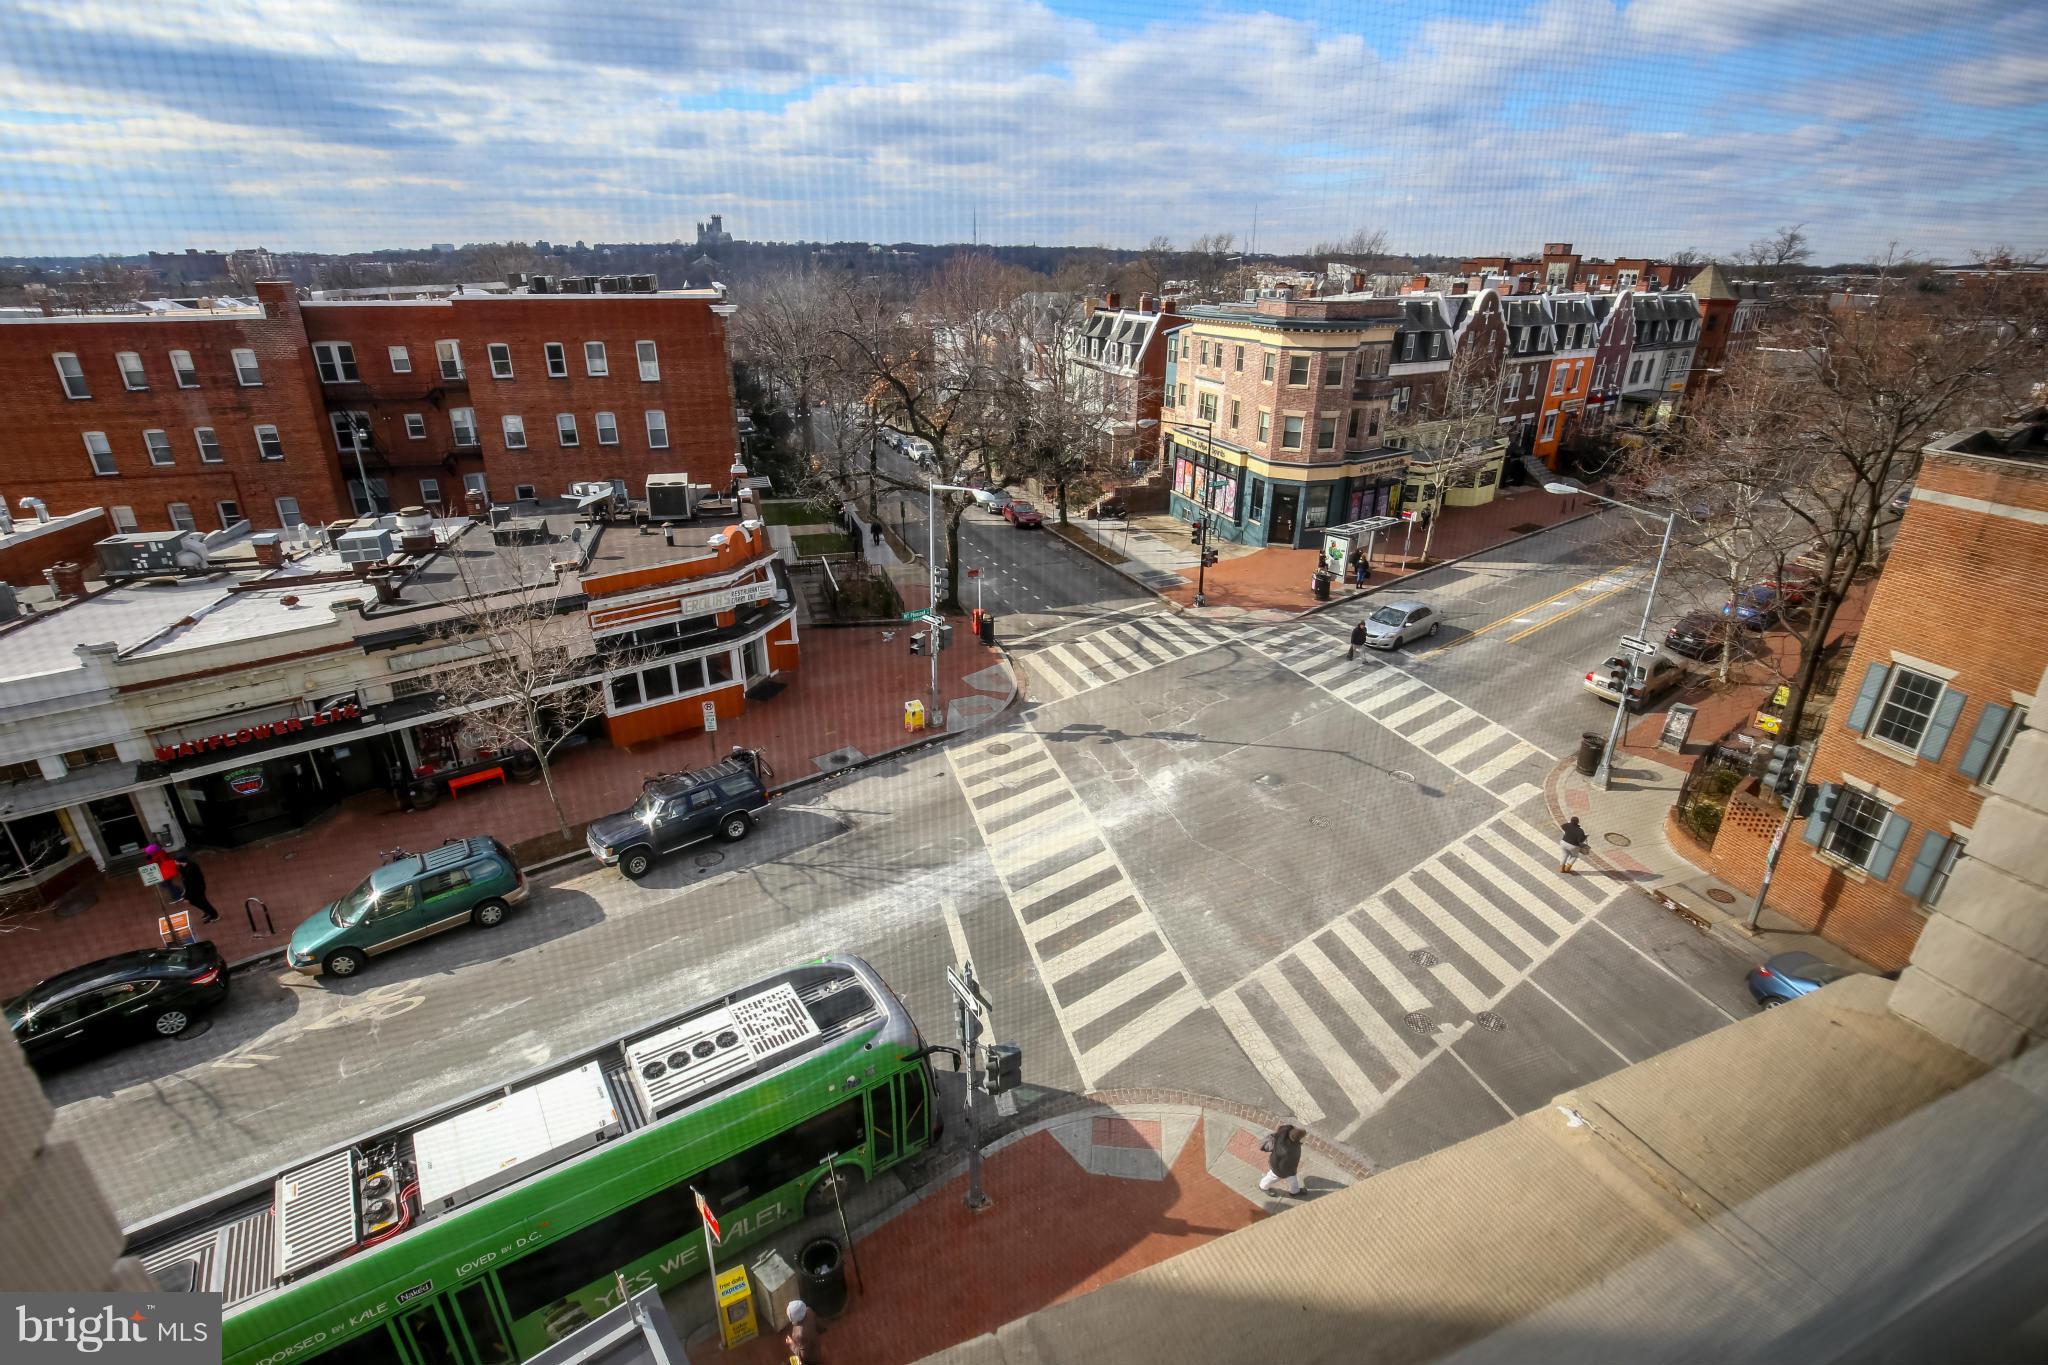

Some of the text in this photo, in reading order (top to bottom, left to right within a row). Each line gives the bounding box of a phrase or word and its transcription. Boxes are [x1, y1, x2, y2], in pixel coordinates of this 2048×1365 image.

[456, 1231, 542, 1277] LOVED BY D.C.
[400, 1283, 430, 1302] Naked
[594, 1269, 653, 1308] YES
[660, 1246, 699, 1275] WE
[721, 1281, 747, 1298] express
[731, 1275, 745, 1287] daily
[255, 1302, 389, 1365] DORSED BY KALE
